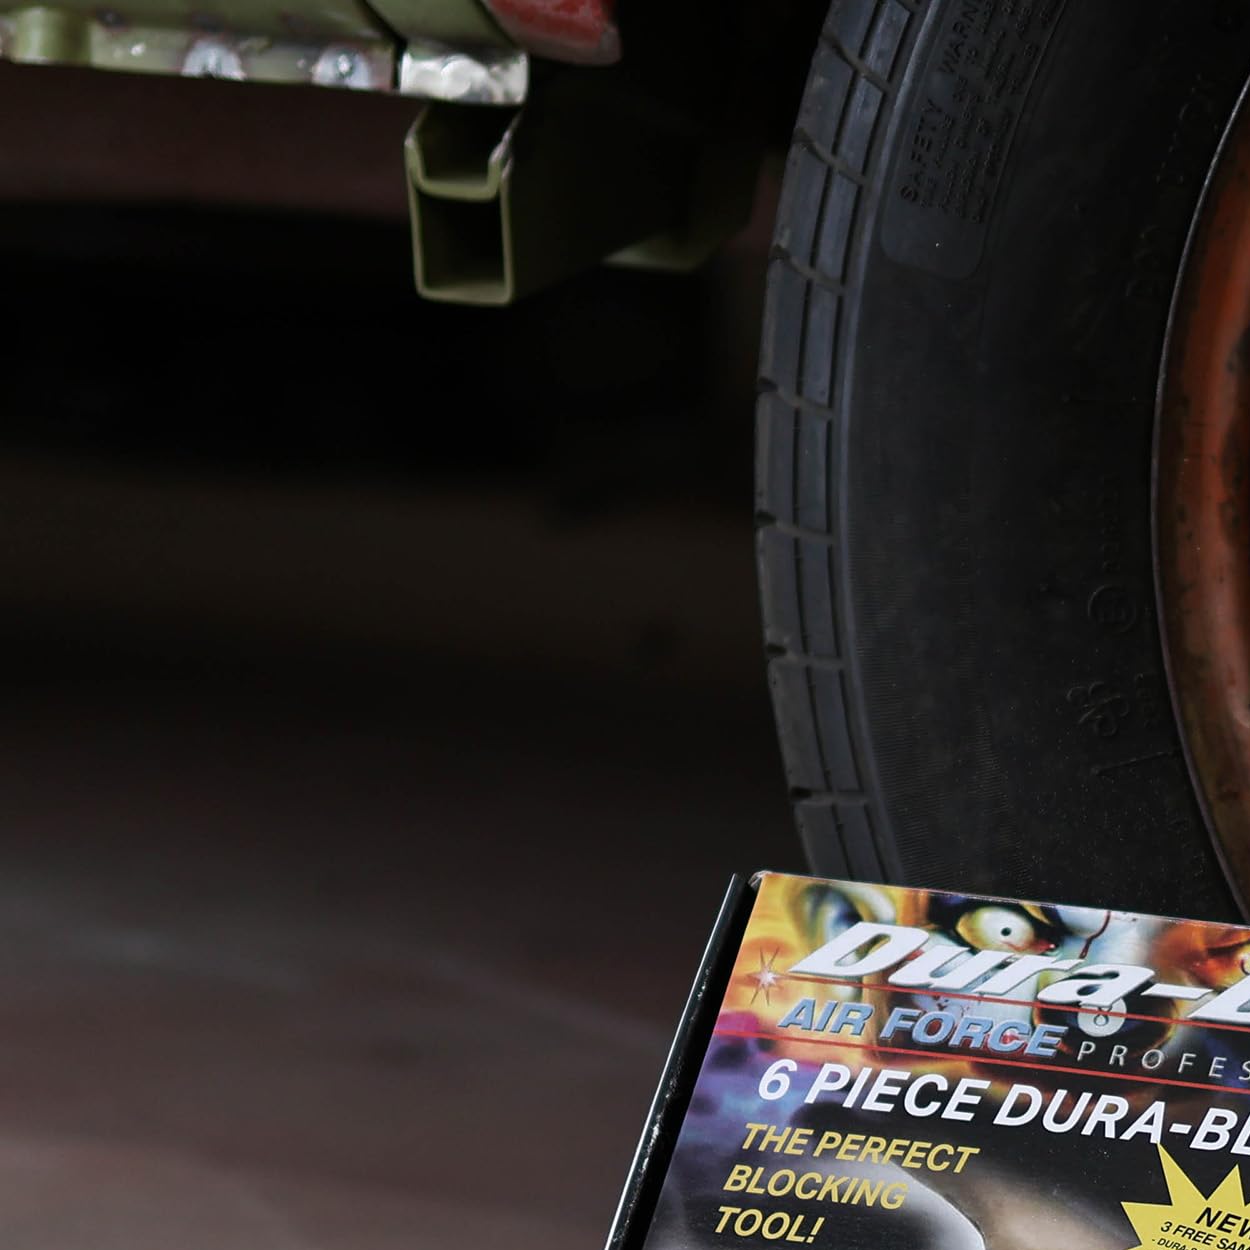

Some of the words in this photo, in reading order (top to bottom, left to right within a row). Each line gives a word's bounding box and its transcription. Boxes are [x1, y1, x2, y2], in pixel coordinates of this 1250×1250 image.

[777, 997, 875, 1036] AIR
[878, 1006, 1069, 1058] FORCE
[758, 1058, 799, 1101] 6
[804, 1063, 991, 1121] PIECE
[741, 1122, 811, 1155] THE
[812, 1132, 980, 1174] PERFECT
[722, 1165, 907, 1211] BLOCKING
[713, 1208, 824, 1245] TOOL!
[1160, 1221, 1173, 1233] 3
[1172, 1224, 1216, 1246] FREE
